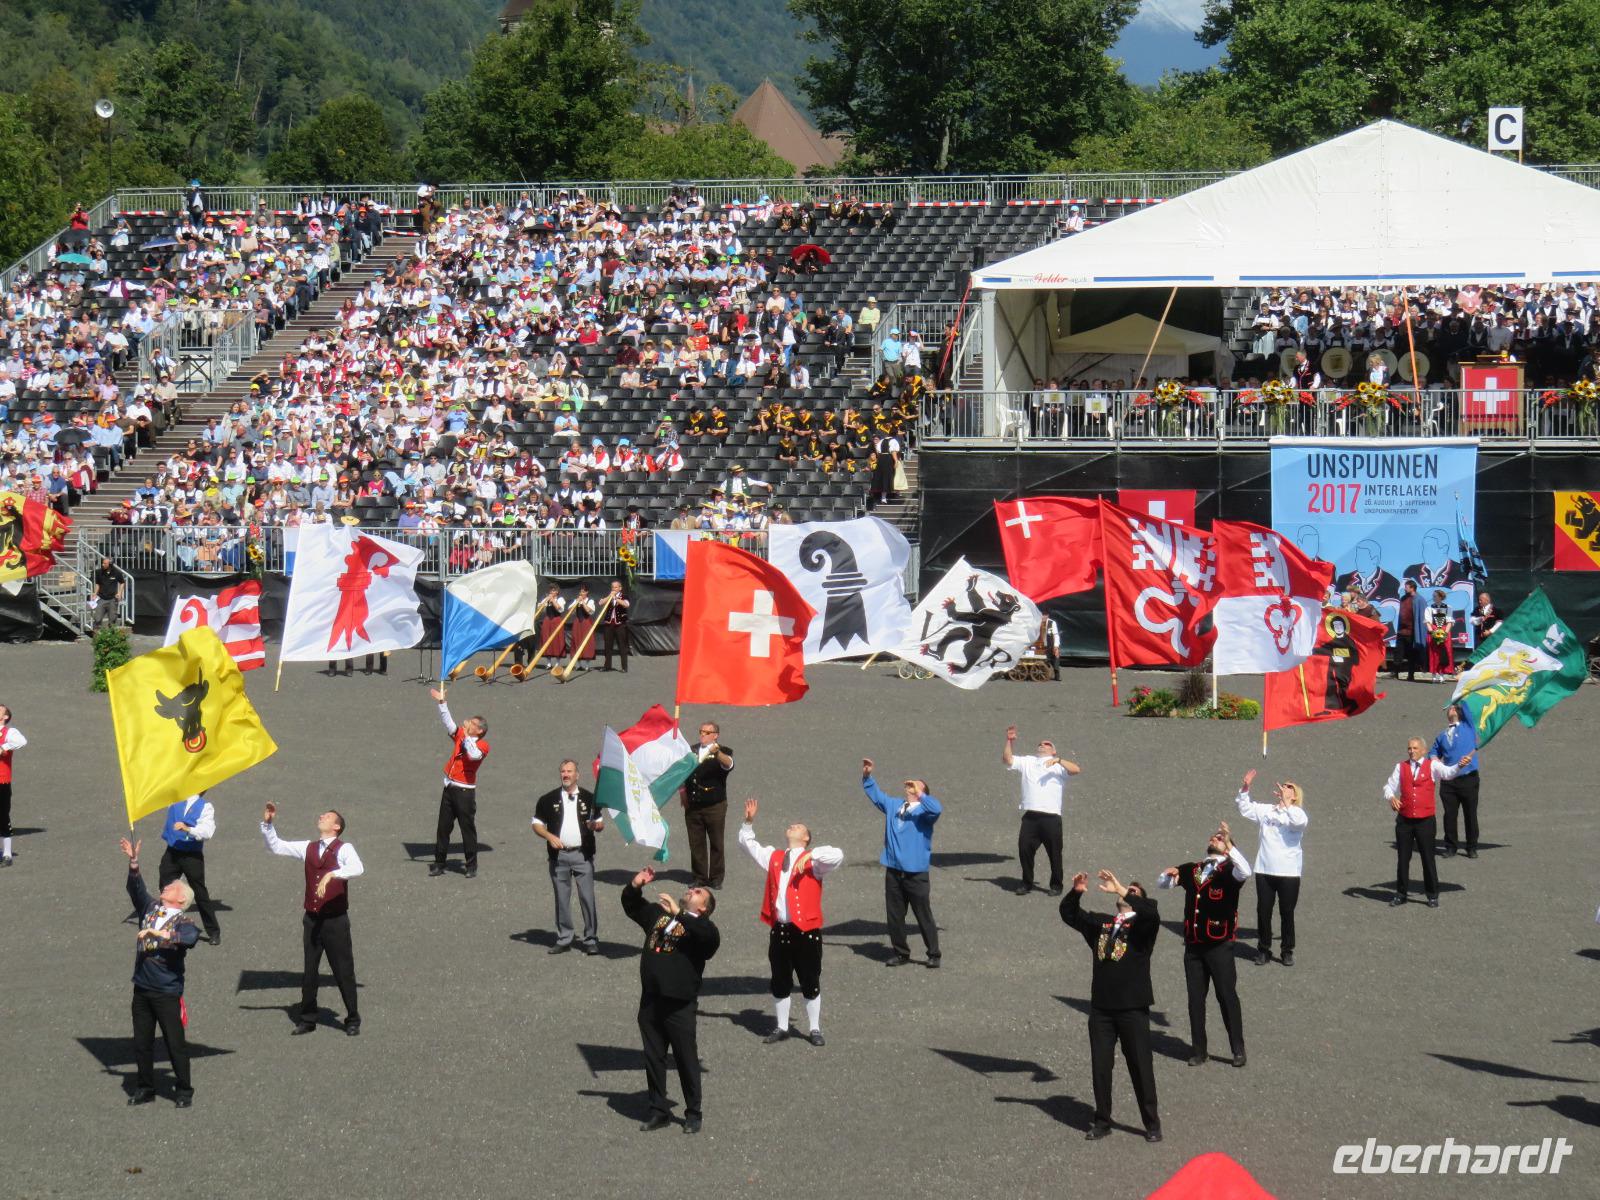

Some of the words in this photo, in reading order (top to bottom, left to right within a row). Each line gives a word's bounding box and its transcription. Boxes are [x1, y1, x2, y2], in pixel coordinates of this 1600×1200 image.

[1494, 113, 1517, 145] C
[1307, 453, 1438, 479] UNSPUNNEN
[1307, 482, 1362, 514] 2017
[1364, 484, 1438, 497] INTERLAKEN
